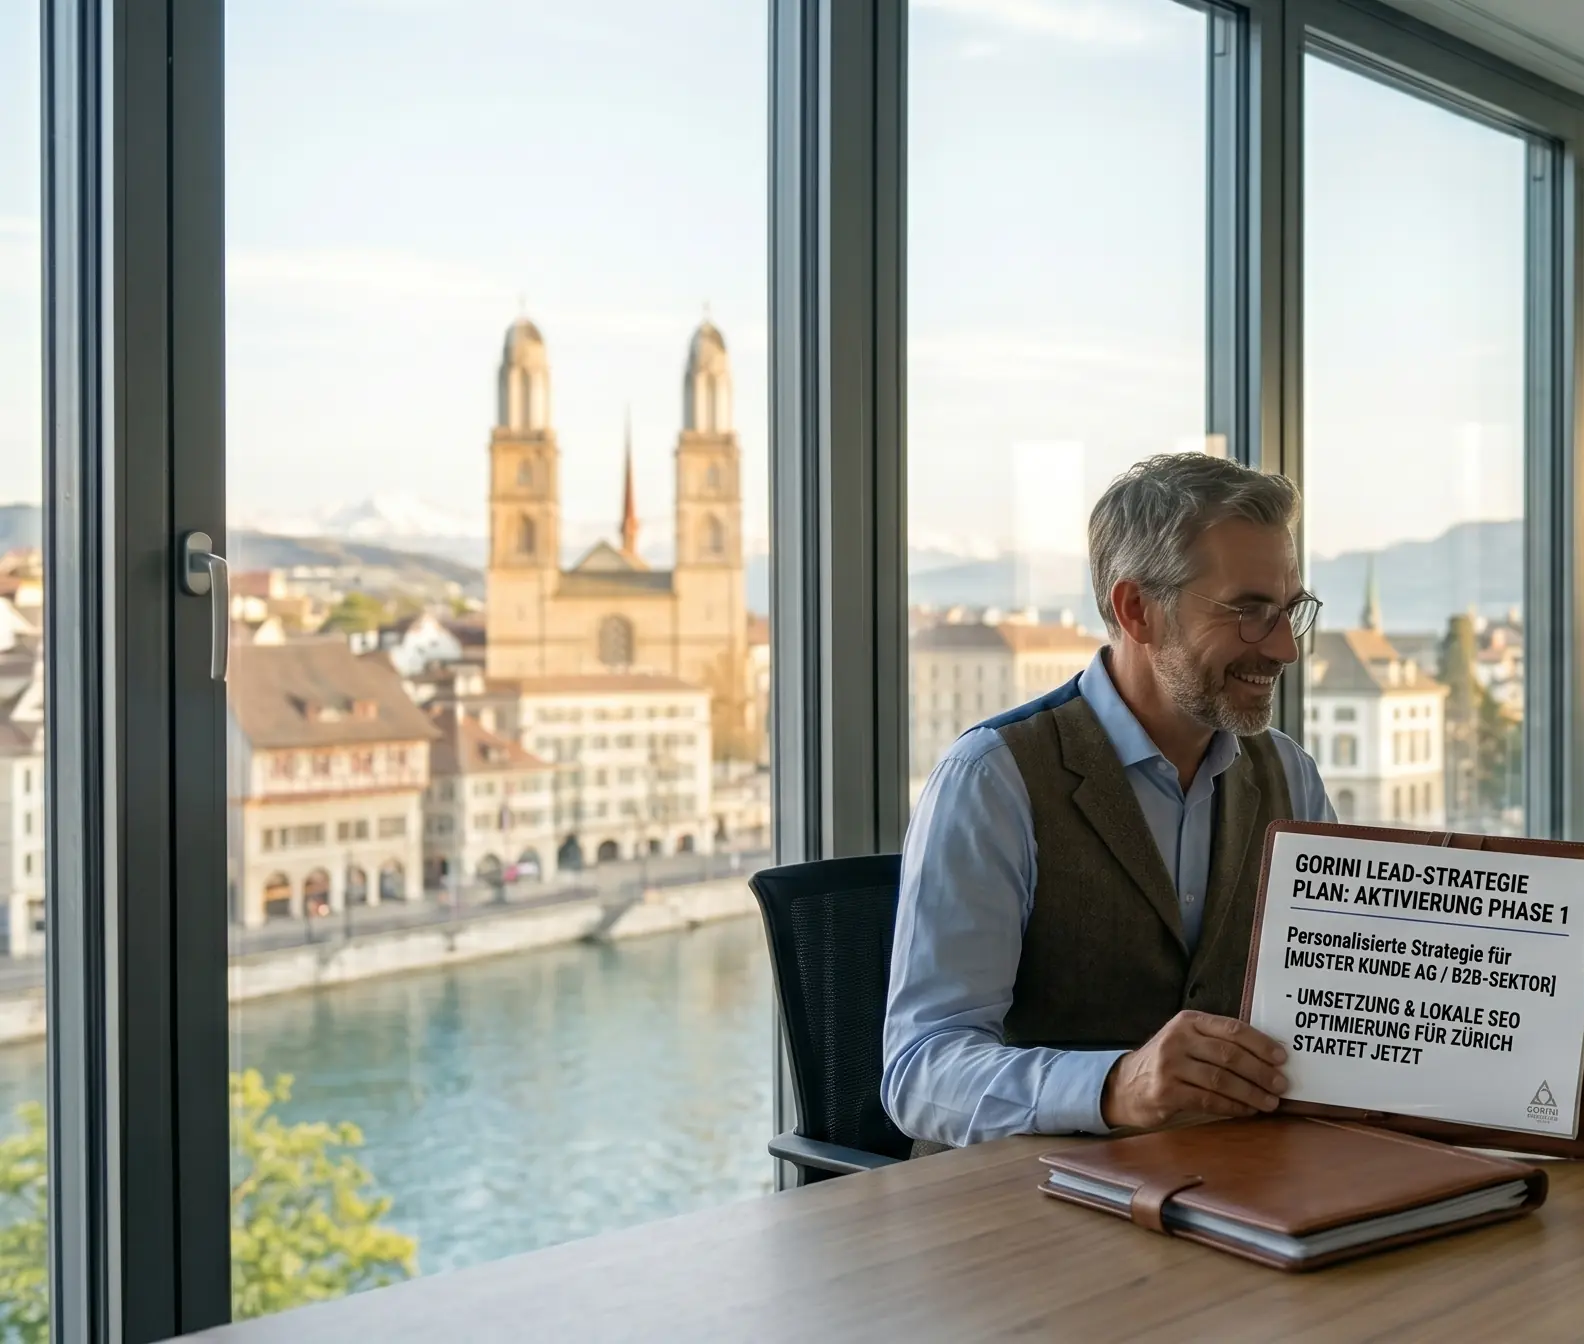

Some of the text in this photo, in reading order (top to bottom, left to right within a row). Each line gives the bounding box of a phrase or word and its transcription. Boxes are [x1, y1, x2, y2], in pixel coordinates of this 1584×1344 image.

[1295, 853, 1530, 895] GORINI LEAD-STRATEGIE
[1292, 878, 1569, 925] PLAN: AKTIVIERUNG PHASE 1
[1287, 925, 1513, 966] Personalisierte Strategie für
[1284, 946, 1355, 973] [MUSTER
[1358, 957, 1412, 979] KUNDE
[1413, 963, 1438, 982] AG
[1451, 966, 1557, 998] B2B-SEKTOR]
[1297, 987, 1400, 1016] UMSETZUNG
[1403, 999, 1416, 1018] &
[1419, 1001, 1485, 1027] LOKALE
[1487, 1009, 1521, 1029] SEO
[1292, 1034, 1424, 1065] STARTET JETZT
[1295, 1011, 1514, 1052] OPTIMIERUNG FÜR ZÜRICH
